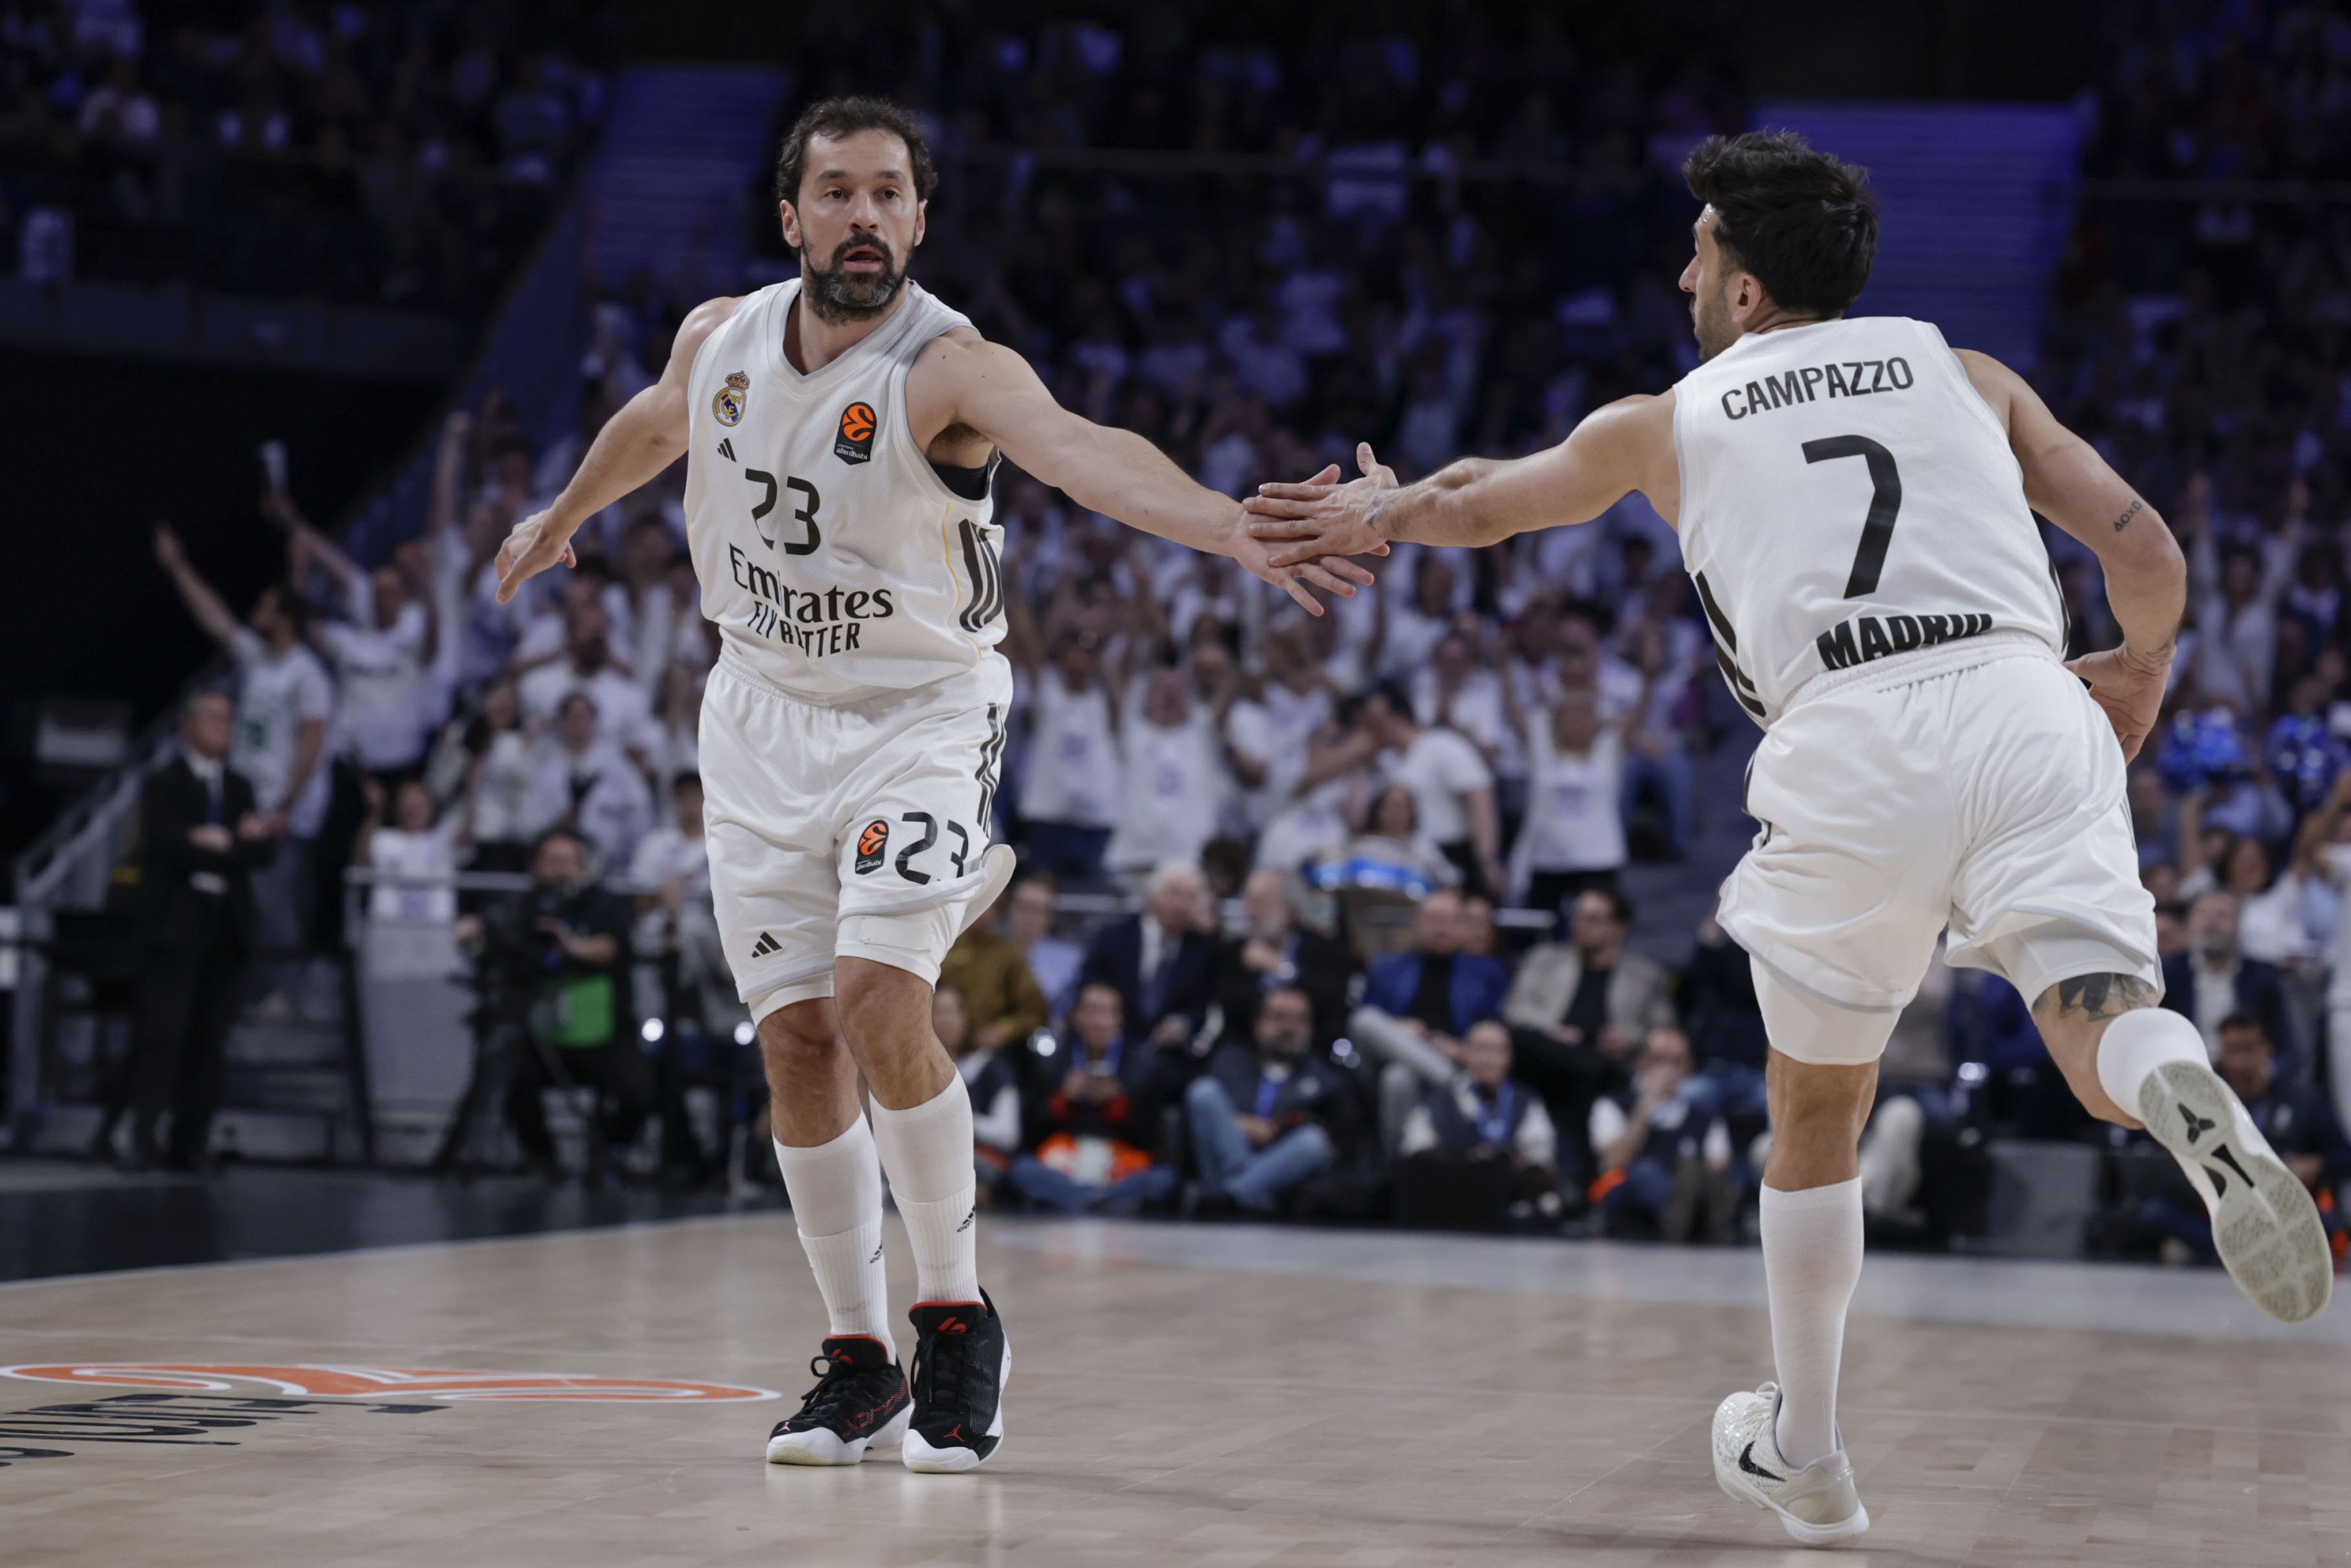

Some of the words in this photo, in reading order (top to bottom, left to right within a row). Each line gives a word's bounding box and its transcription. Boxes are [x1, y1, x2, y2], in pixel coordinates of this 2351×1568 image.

[1721, 357, 1914, 420] CAMPAZZO
[836, 447, 849, 456] abu
[849, 450, 868, 460] dhabi
[746, 468, 822, 556] 23
[1801, 434, 1903, 600] 7
[747, 601, 778, 640] FLY
[894, 811, 969, 885] 23
